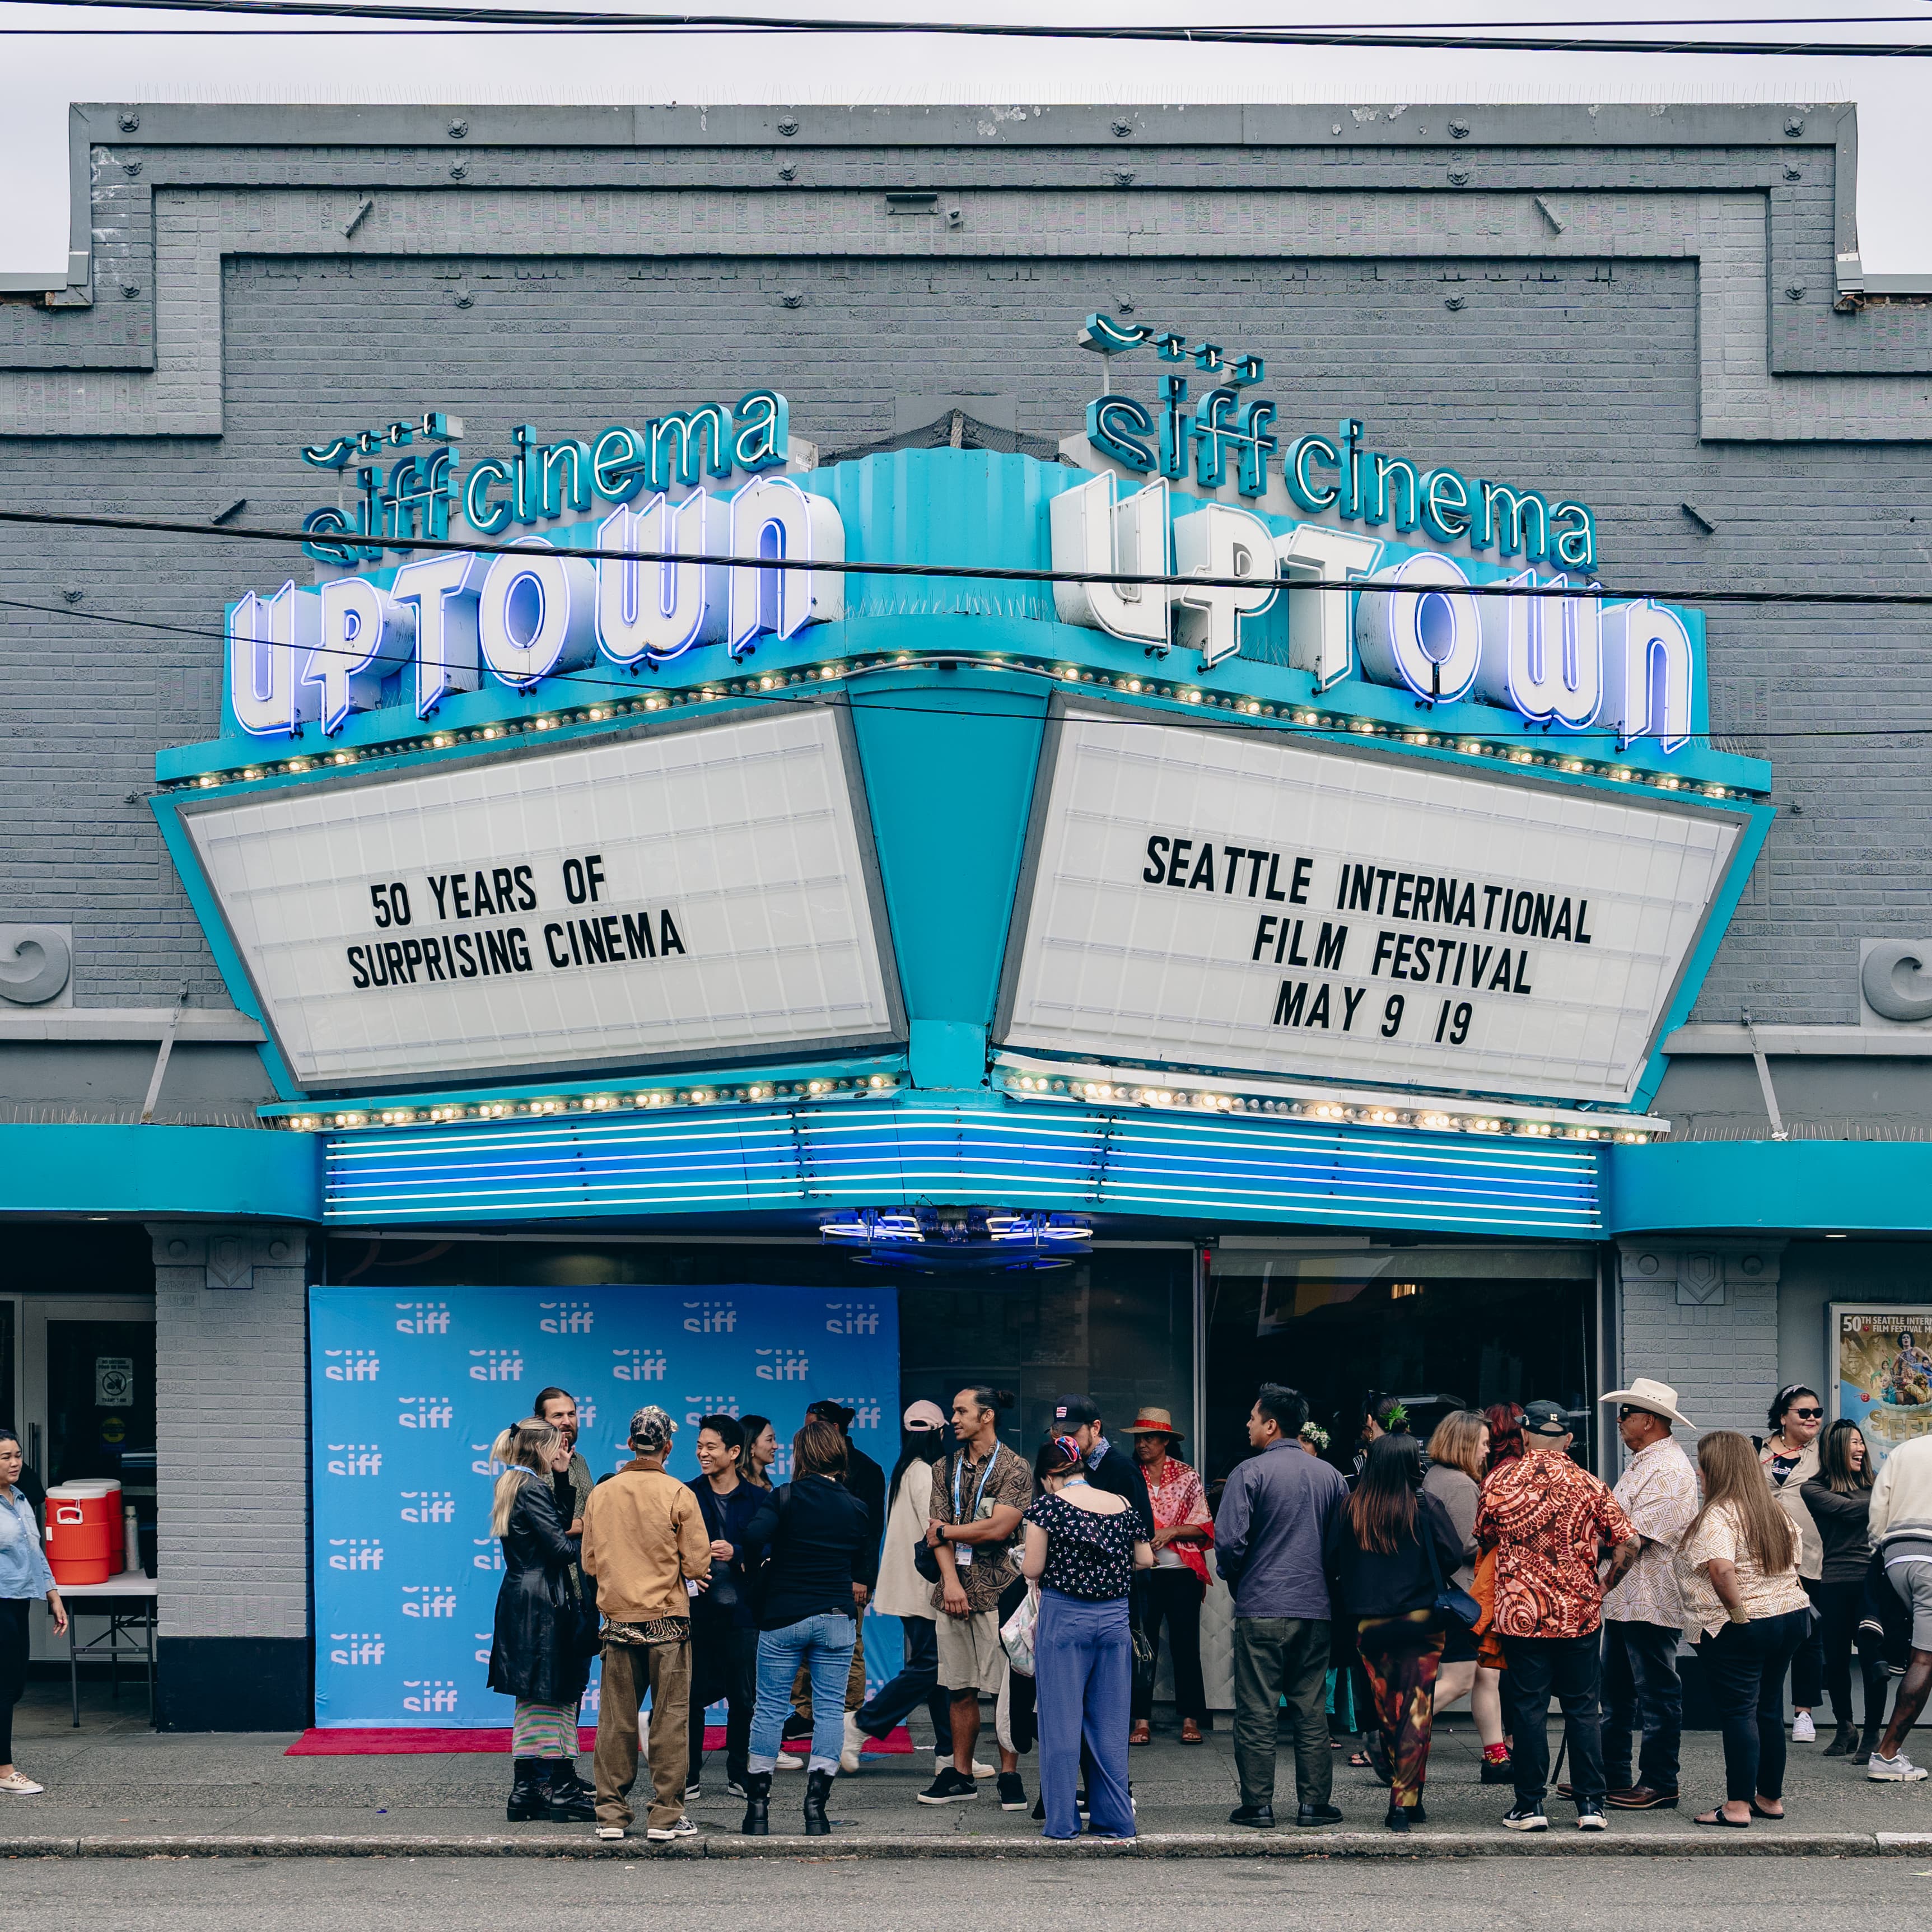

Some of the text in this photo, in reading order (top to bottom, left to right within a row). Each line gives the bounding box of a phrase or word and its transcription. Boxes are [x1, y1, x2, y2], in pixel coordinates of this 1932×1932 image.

[301, 389, 790, 567] siff cinema
[1086, 374, 1598, 573] siff cinema
[229, 474, 846, 736] UPTOWN
[1051, 469, 1693, 755] UPTOWN
[370, 855, 605, 928] 50 YEARS OF
[1143, 836, 1592, 944] SEATTLE INTERNATIONAL
[347, 909, 686, 988] SURPRISING CINEMA
[1252, 914, 1532, 995] FILM FESTIVAL
[1273, 980, 1473, 1045] MAY 9 19
[396, 1312, 450, 1333] siff
[540, 1312, 593, 1333] siff
[683, 1311, 736, 1332] siff
[826, 1312, 879, 1334] siff
[326, 1359, 379, 1381] siff
[470, 1359, 522, 1380] siff
[613, 1359, 666, 1380] siff
[756, 1359, 808, 1380] siff
[399, 1407, 452, 1428] siff
[576, 1406, 596, 1427] ff
[328, 1454, 382, 1476] siff
[401, 1501, 454, 1523] siff
[329, 1548, 384, 1570] siff
[402, 1595, 456, 1617] siff
[330, 1642, 385, 1665] siff
[403, 1690, 458, 1712] siff
